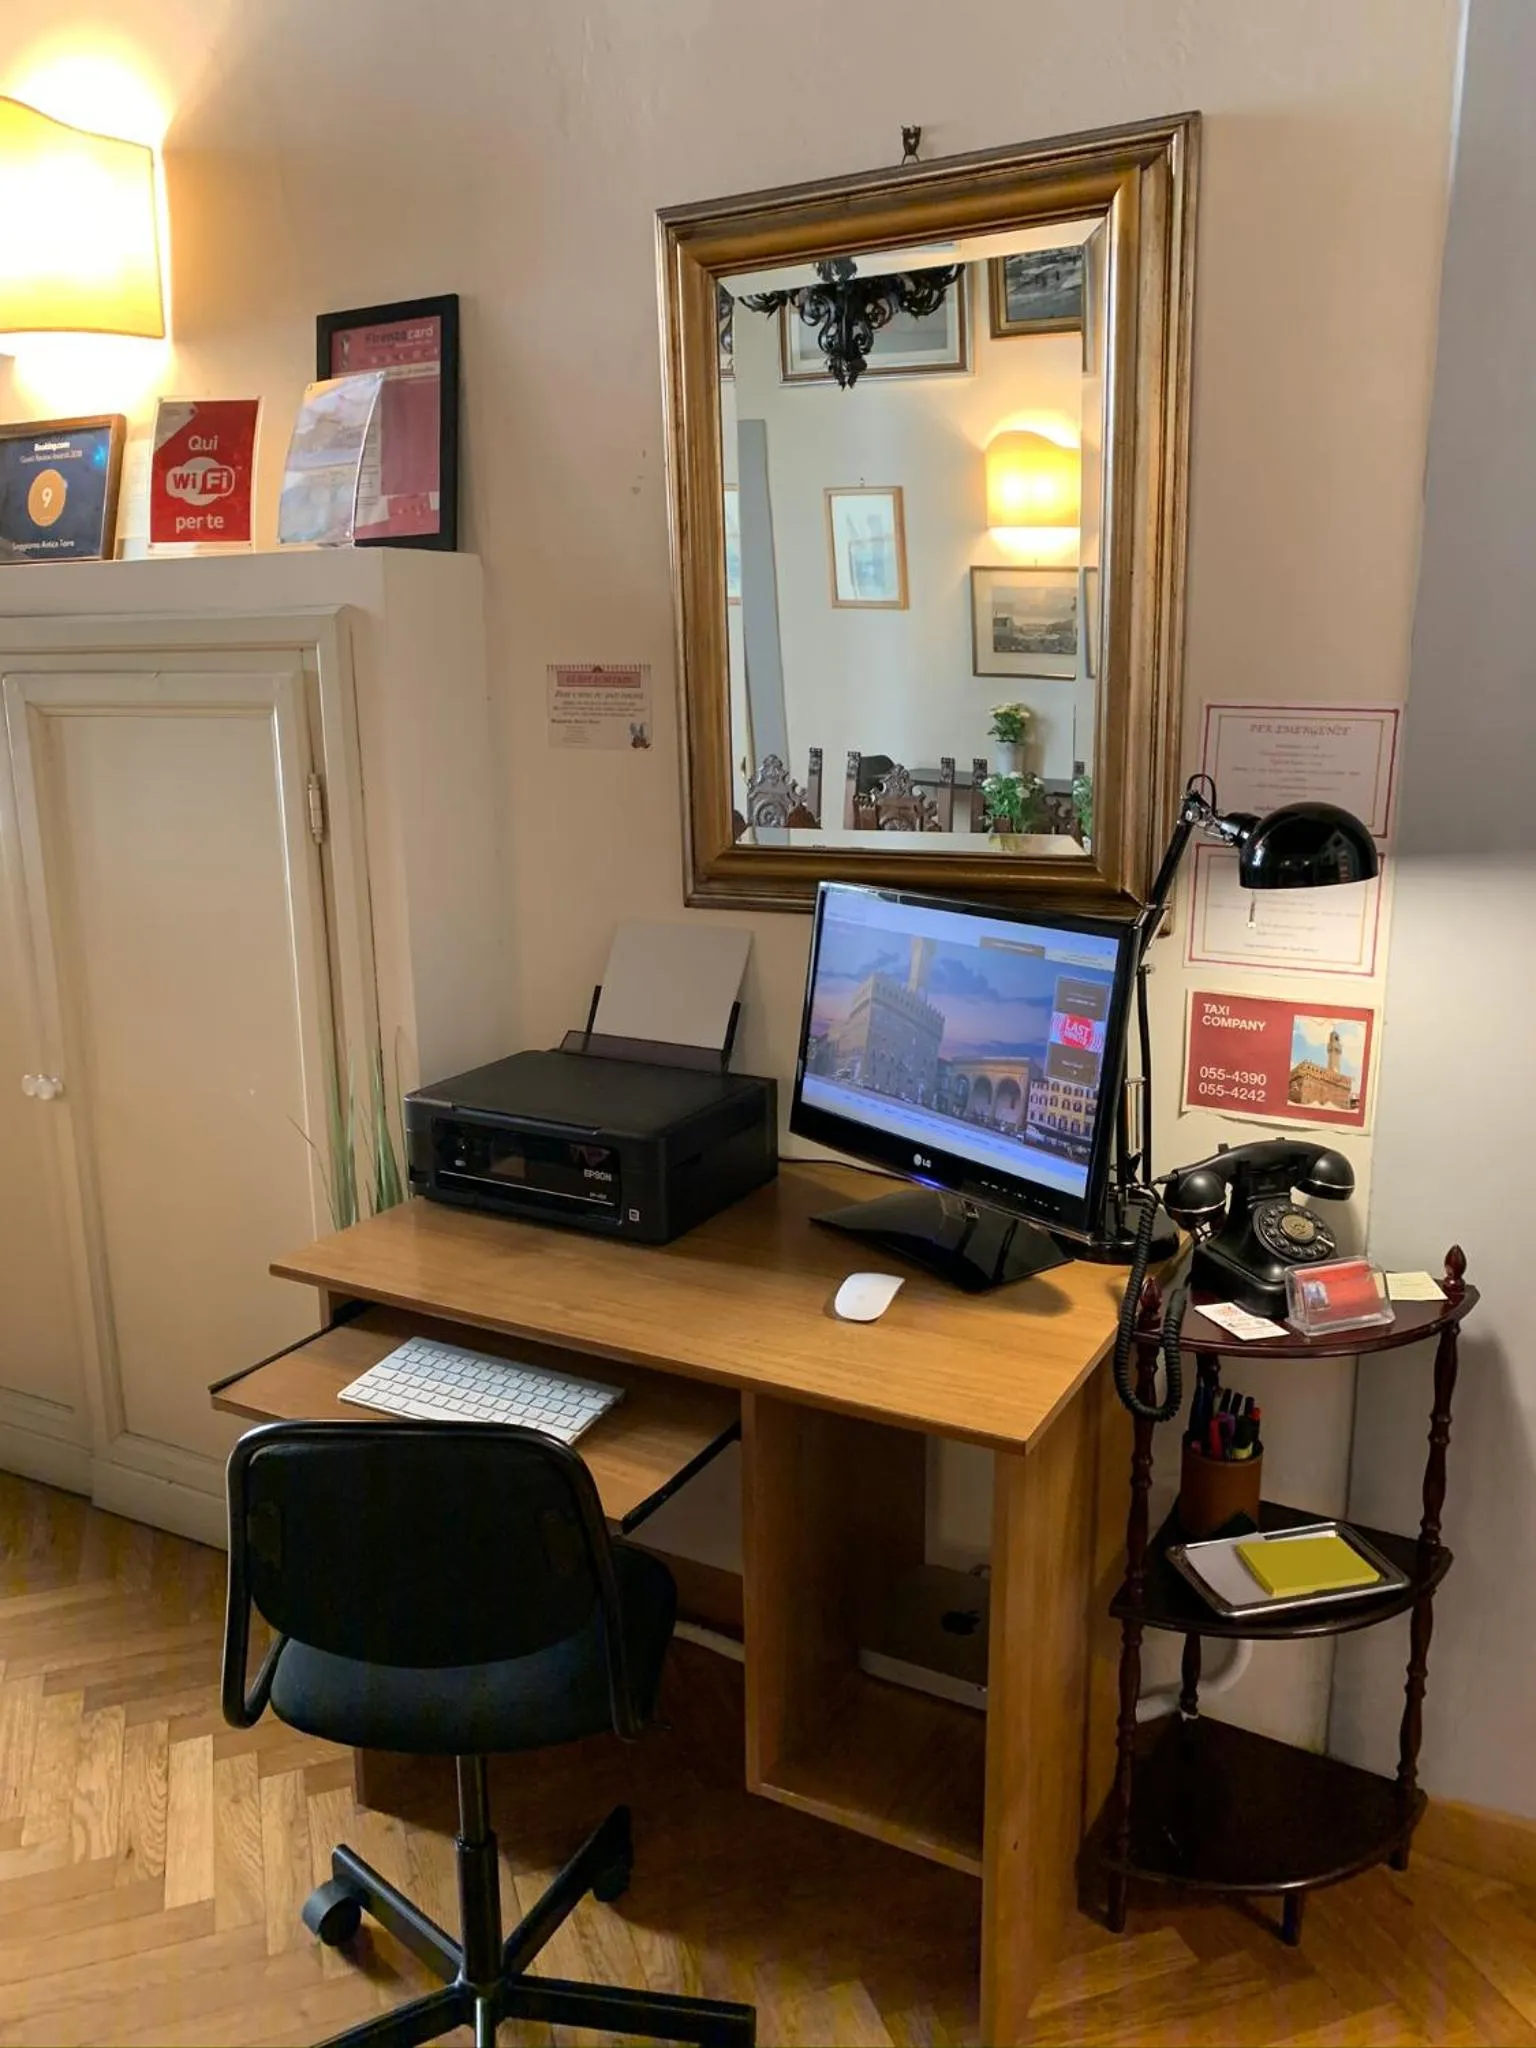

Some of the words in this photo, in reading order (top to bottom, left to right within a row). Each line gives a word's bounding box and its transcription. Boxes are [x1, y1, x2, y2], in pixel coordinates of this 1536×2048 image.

[188, 435, 218, 450] Qui
[42, 487, 52, 508] 9
[175, 515, 203, 534] per
[207, 513, 224, 529] te
[1203, 1003, 1230, 1016] TAXI
[1202, 1015, 1266, 1032] COMPANY
[1200, 1065, 1267, 1086] 055-4390
[1199, 1082, 1266, 1103] 055-4242
[584, 1168, 612, 1182] EPSON
